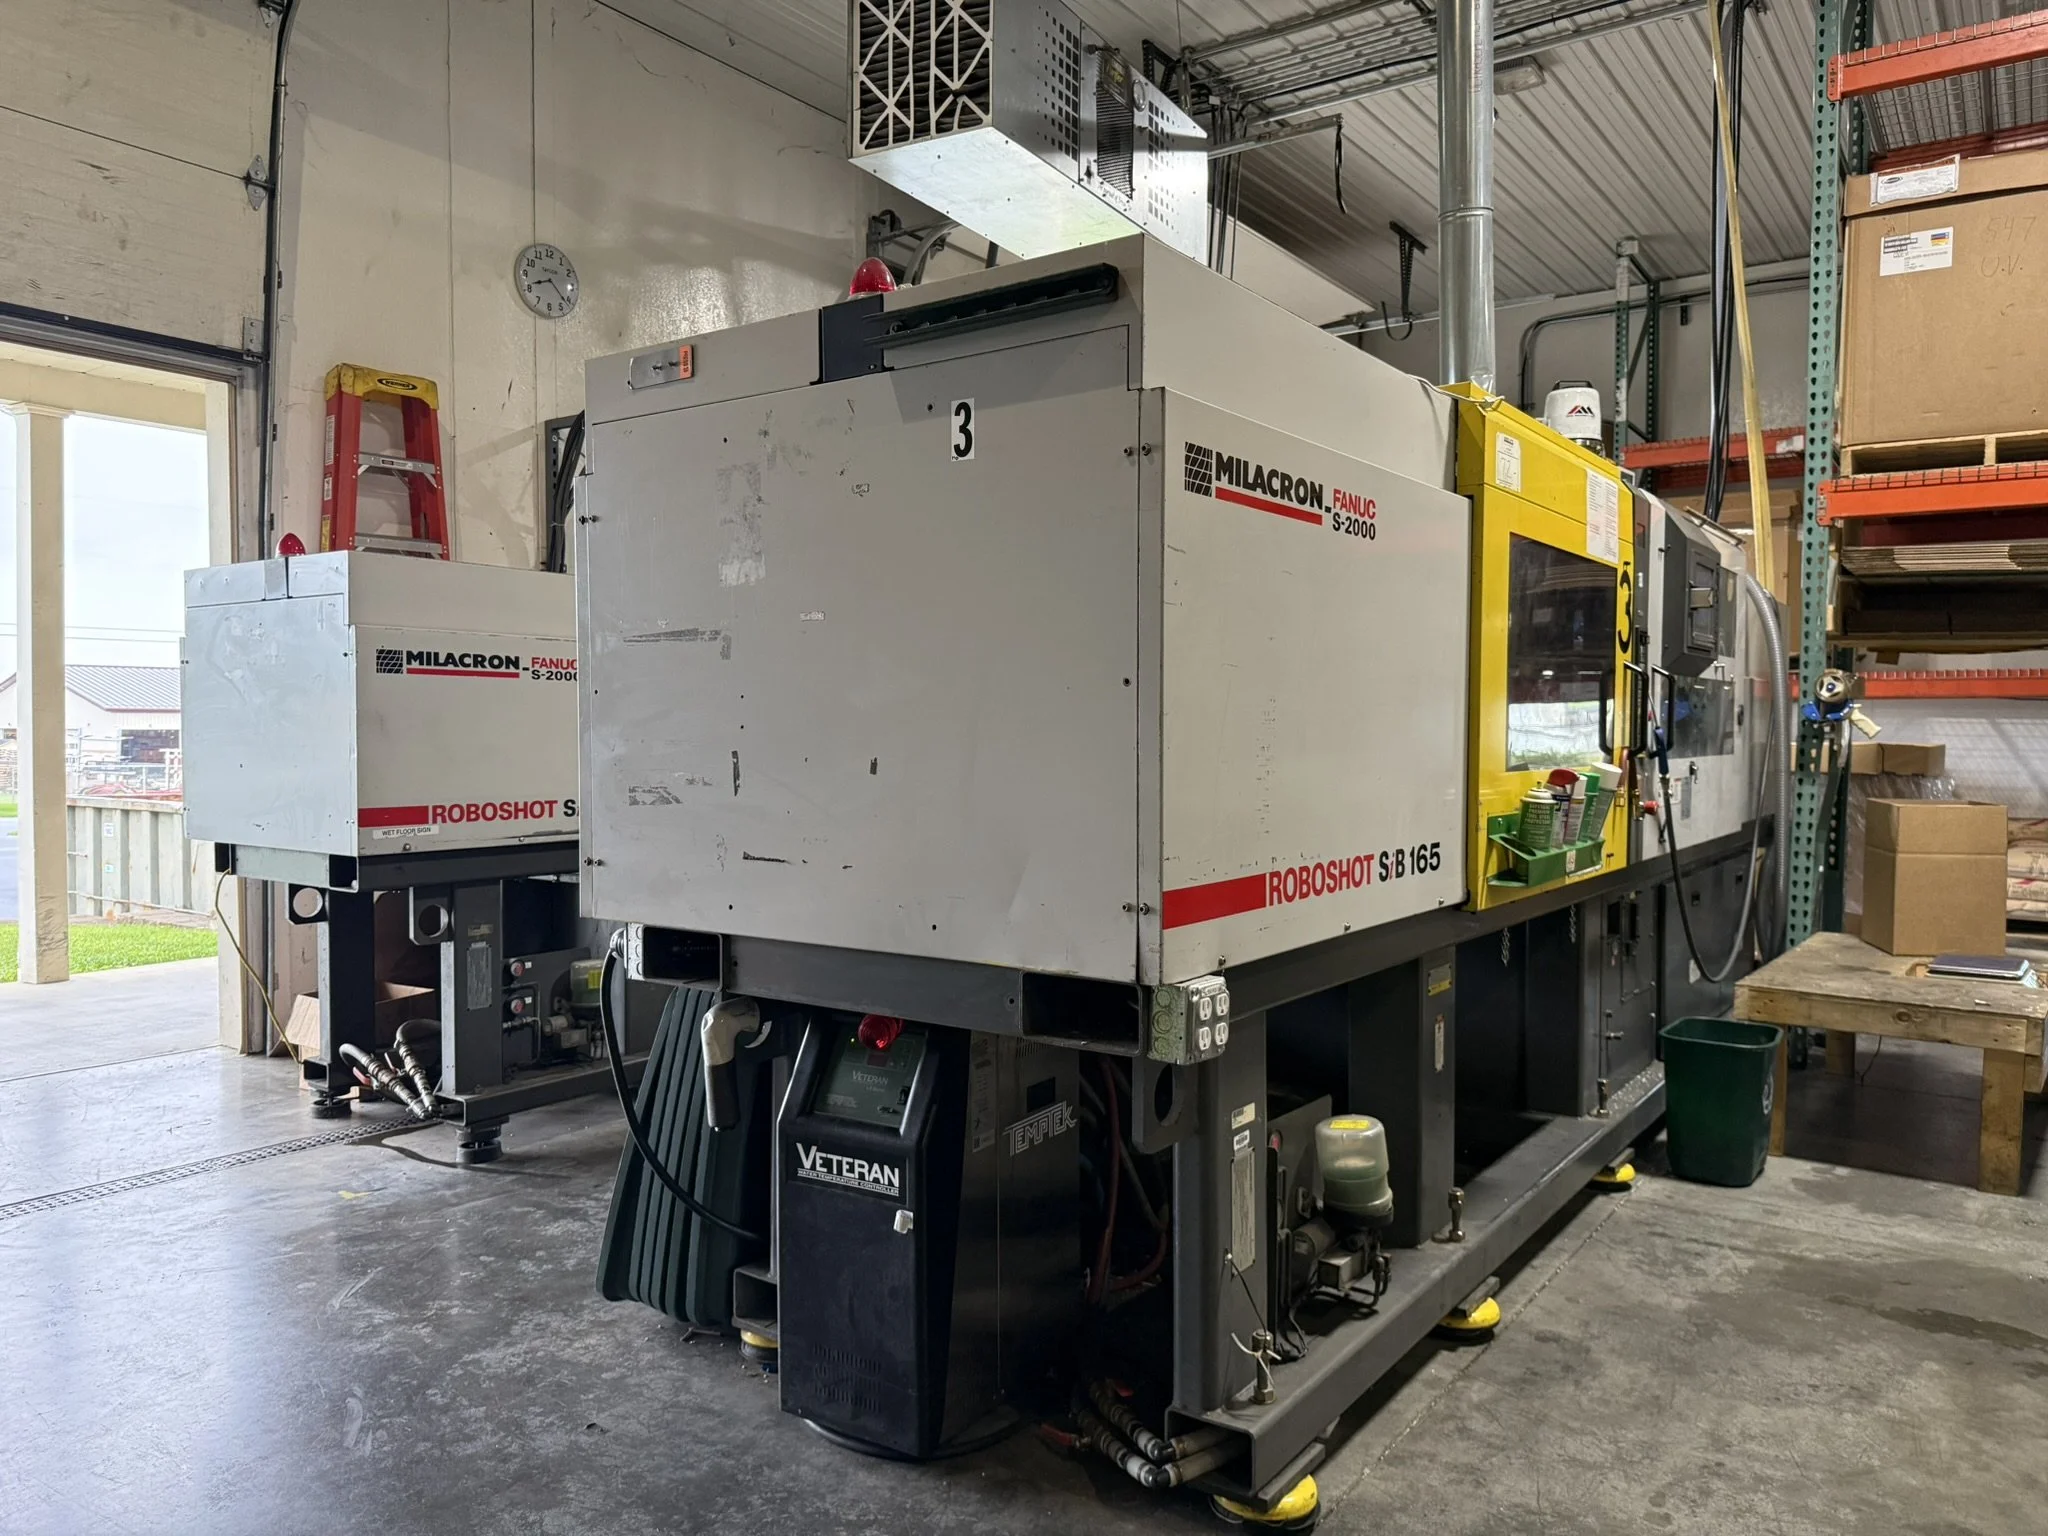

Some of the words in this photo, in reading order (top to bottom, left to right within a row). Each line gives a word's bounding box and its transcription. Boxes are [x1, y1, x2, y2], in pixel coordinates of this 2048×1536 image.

[953, 401, 973, 458] 3
[1333, 488, 1376, 520] FANUC
[1332, 512, 1376, 541] S-2000
[431, 800, 558, 824] ROBOSHOT
[396, 828, 416, 836] FLOOR
[1268, 854, 1374, 907] ROBOSHOT
[1410, 841, 1441, 876] 165
[795, 1142, 899, 1188] VETERAN
[798, 1169, 817, 1177] WATER
[818, 1173, 859, 1186] TEMPERATURE
[860, 1181, 899, 1194] CONTROLLER
